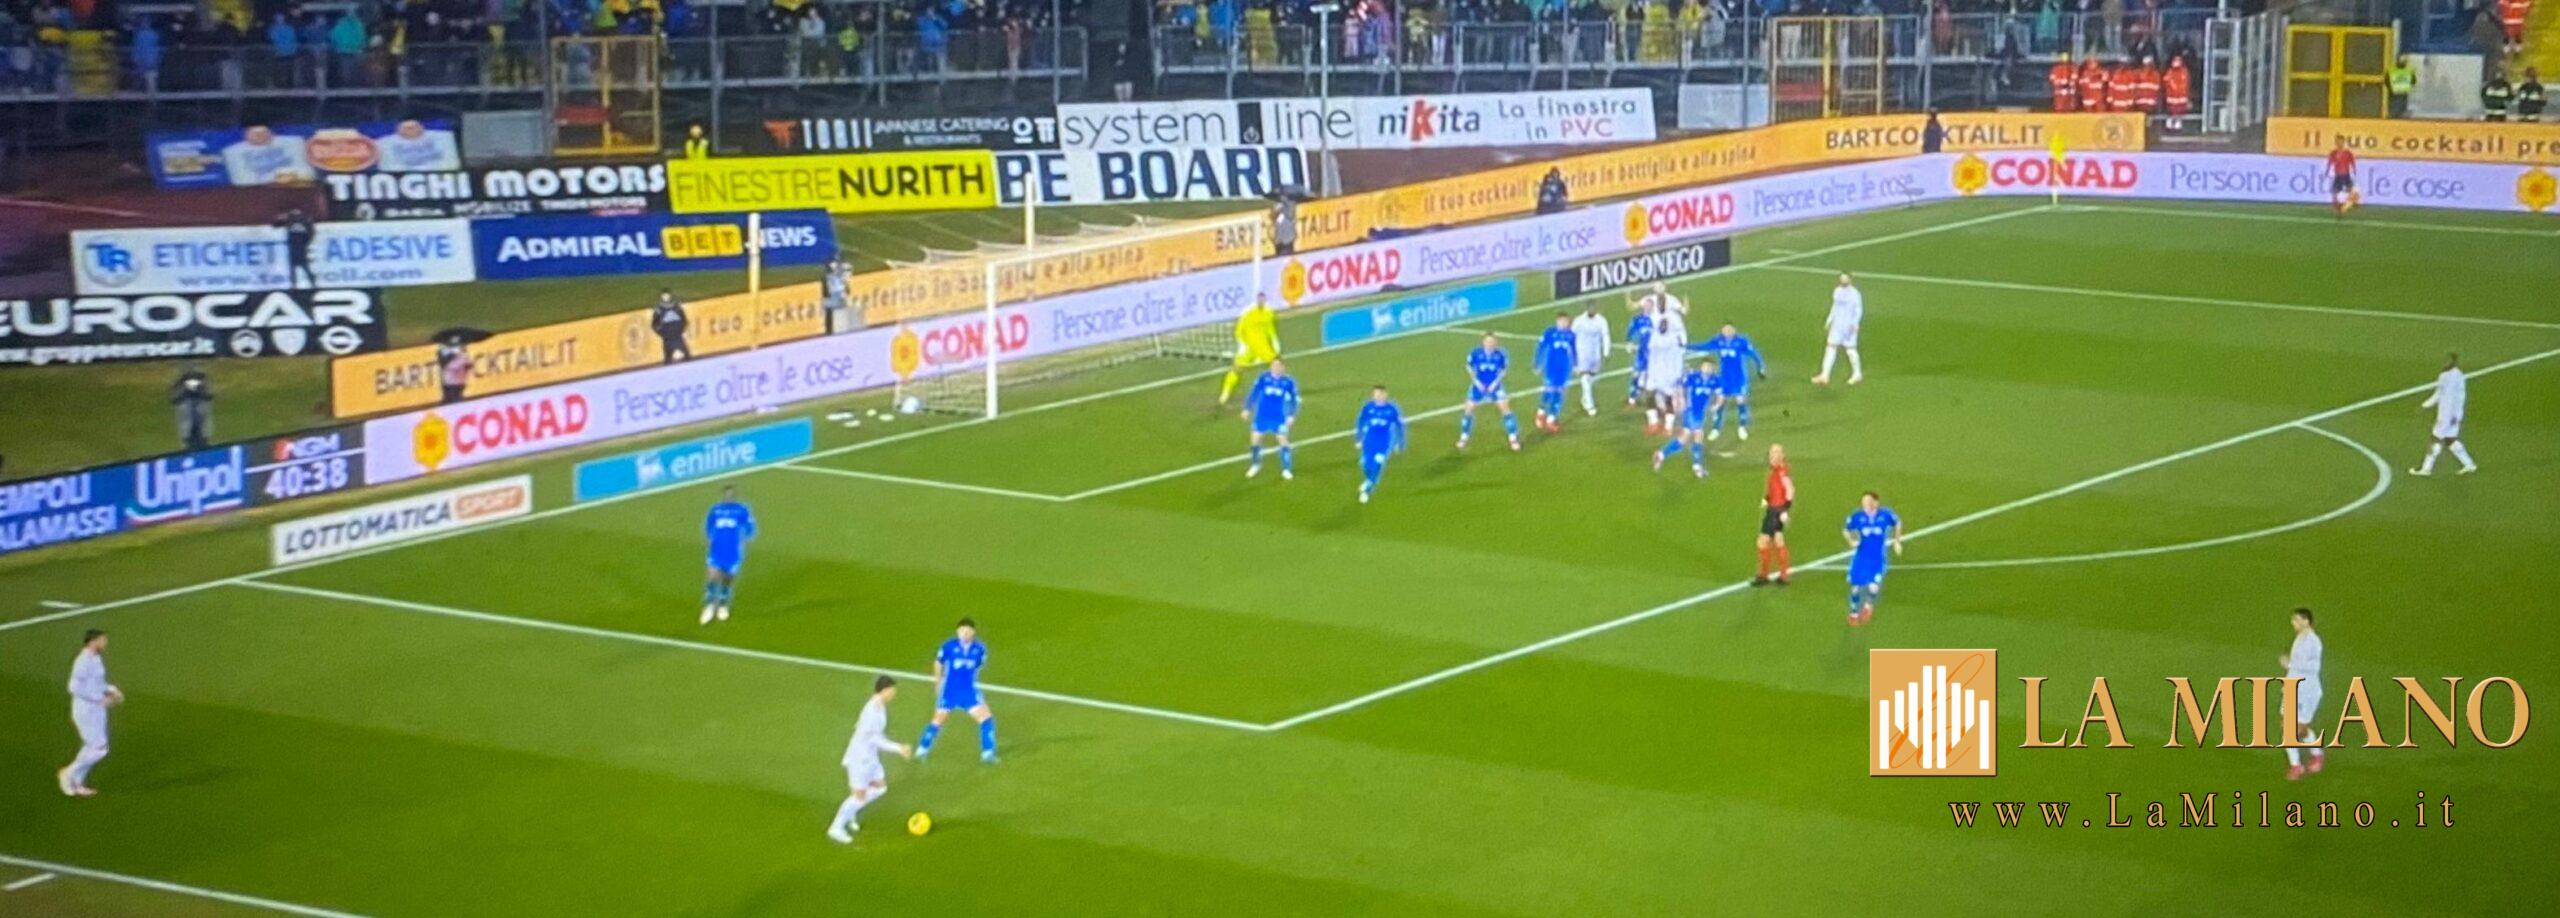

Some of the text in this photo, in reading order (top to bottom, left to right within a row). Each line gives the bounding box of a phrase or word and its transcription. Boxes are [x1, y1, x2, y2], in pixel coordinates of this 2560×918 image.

[1064, 101, 1354, 149] system line
[1377, 98, 1481, 143] nikita
[1526, 118, 1615, 141] in PVC
[1826, 124, 2043, 150] BARTCOKTAIL.IT
[2390, 131, 2505, 154] cocktail
[326, 163, 666, 201] TINGHI MOTORS
[838, 163, 986, 200] NURITH
[998, 146, 1304, 203] BE BOARD
[1990, 158, 2138, 189] CONAD
[2169, 163, 2278, 192] Persone
[2367, 167, 2392, 196] le
[2402, 175, 2466, 200] cose
[1647, 193, 1735, 235] CONAD
[1753, 186, 1816, 217] Persone
[325, 234, 453, 263] ADESIVE
[496, 231, 663, 263] ADMIRAL
[1306, 248, 1401, 293] CONAD
[1418, 243, 1489, 276] Persone
[1492, 231, 1533, 263] oltre
[1558, 225, 1598, 251] cose
[1579, 245, 1704, 292] LINO SONEGO
[0, 290, 374, 338] UROCAR
[1051, 306, 1126, 342] Persone
[1132, 291, 1176, 327] oltre
[1205, 284, 1246, 313] cose
[1398, 293, 1471, 326] enilive
[453, 393, 589, 455] CONAD
[613, 382, 709, 424] Persone
[715, 364, 770, 404] oltre
[803, 354, 855, 387] cose
[136, 445, 244, 515] Unipol
[264, 457, 349, 499] 40:38
[669, 439, 757, 478] enilive
[284, 500, 451, 555] LOTTOMATICA
